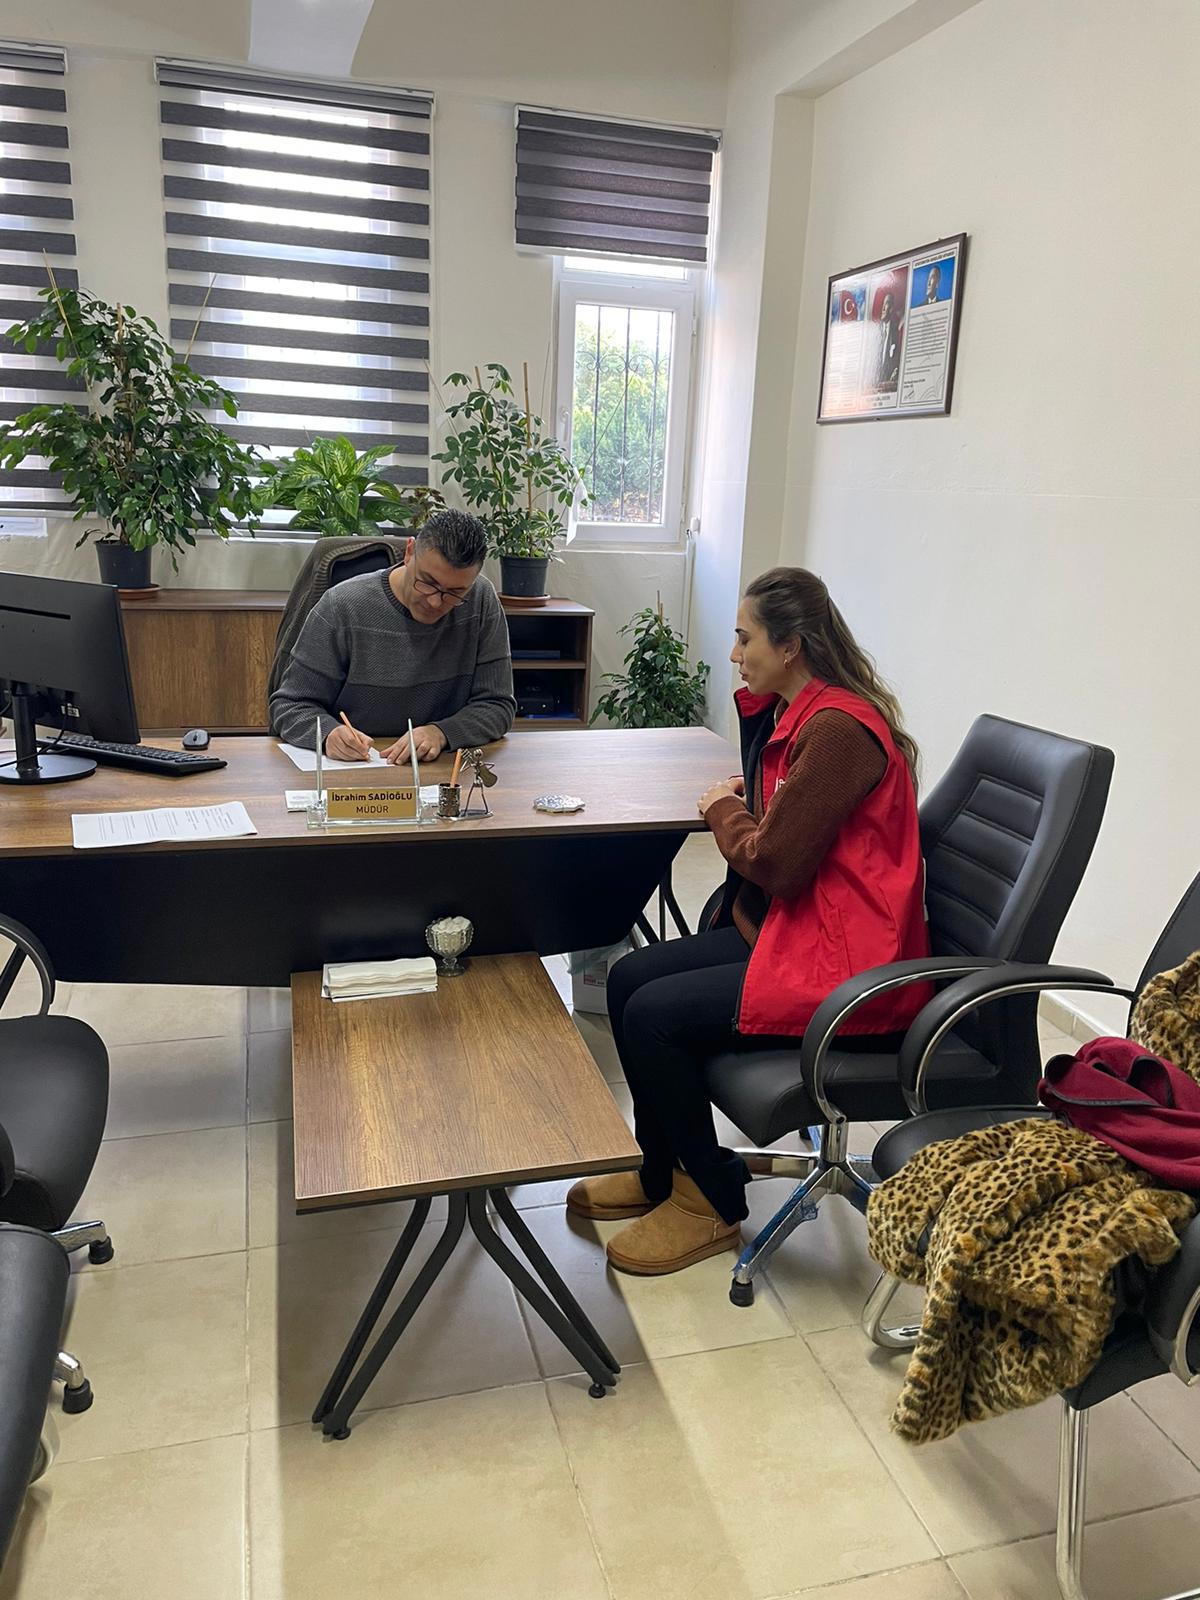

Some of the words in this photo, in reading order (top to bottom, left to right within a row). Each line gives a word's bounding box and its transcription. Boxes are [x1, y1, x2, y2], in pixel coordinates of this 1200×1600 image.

[331, 792, 366, 802] İbrahim
[368, 791, 413, 801] SADİOĞLU
[356, 804, 389, 814] MÜDÜR
